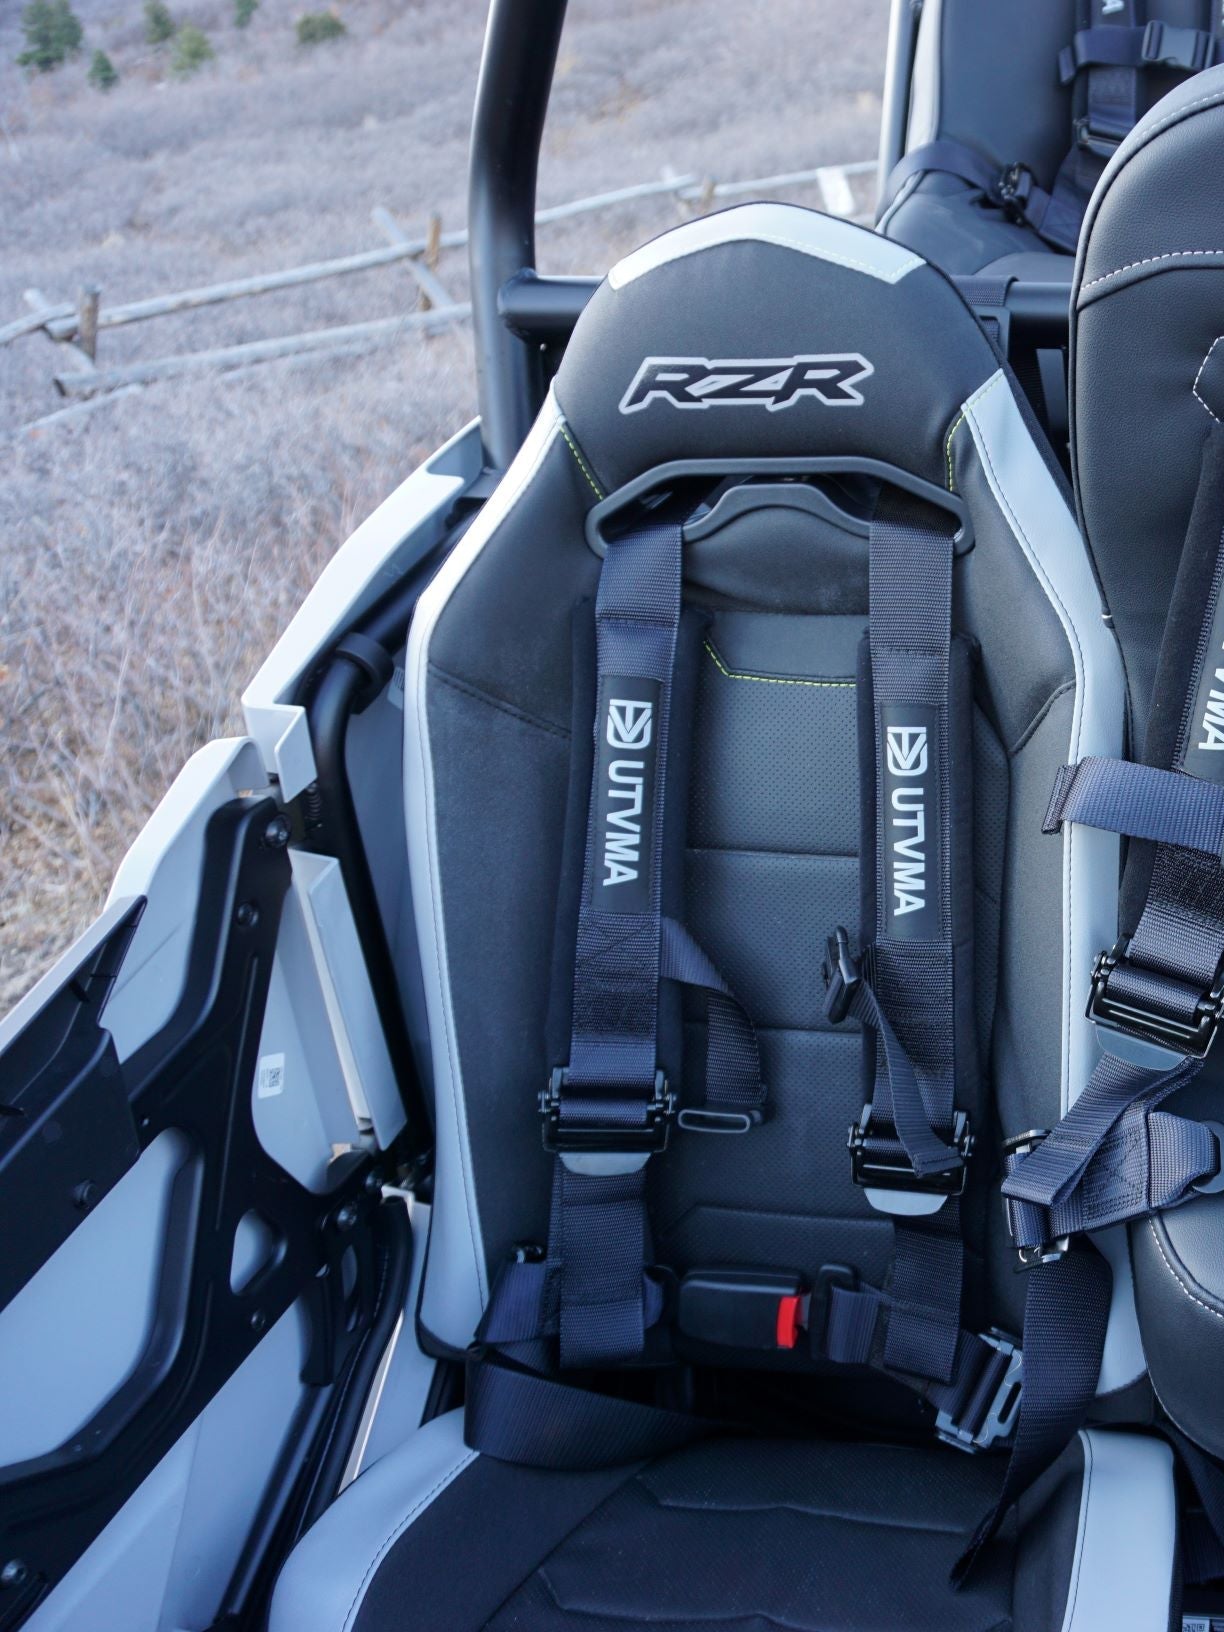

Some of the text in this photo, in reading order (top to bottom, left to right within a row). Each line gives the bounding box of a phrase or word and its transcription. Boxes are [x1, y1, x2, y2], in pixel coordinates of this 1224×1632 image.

[619, 353, 874, 414] RZR
[603, 760, 644, 886] UTVMA
[892, 788, 925, 916] UTVMA
